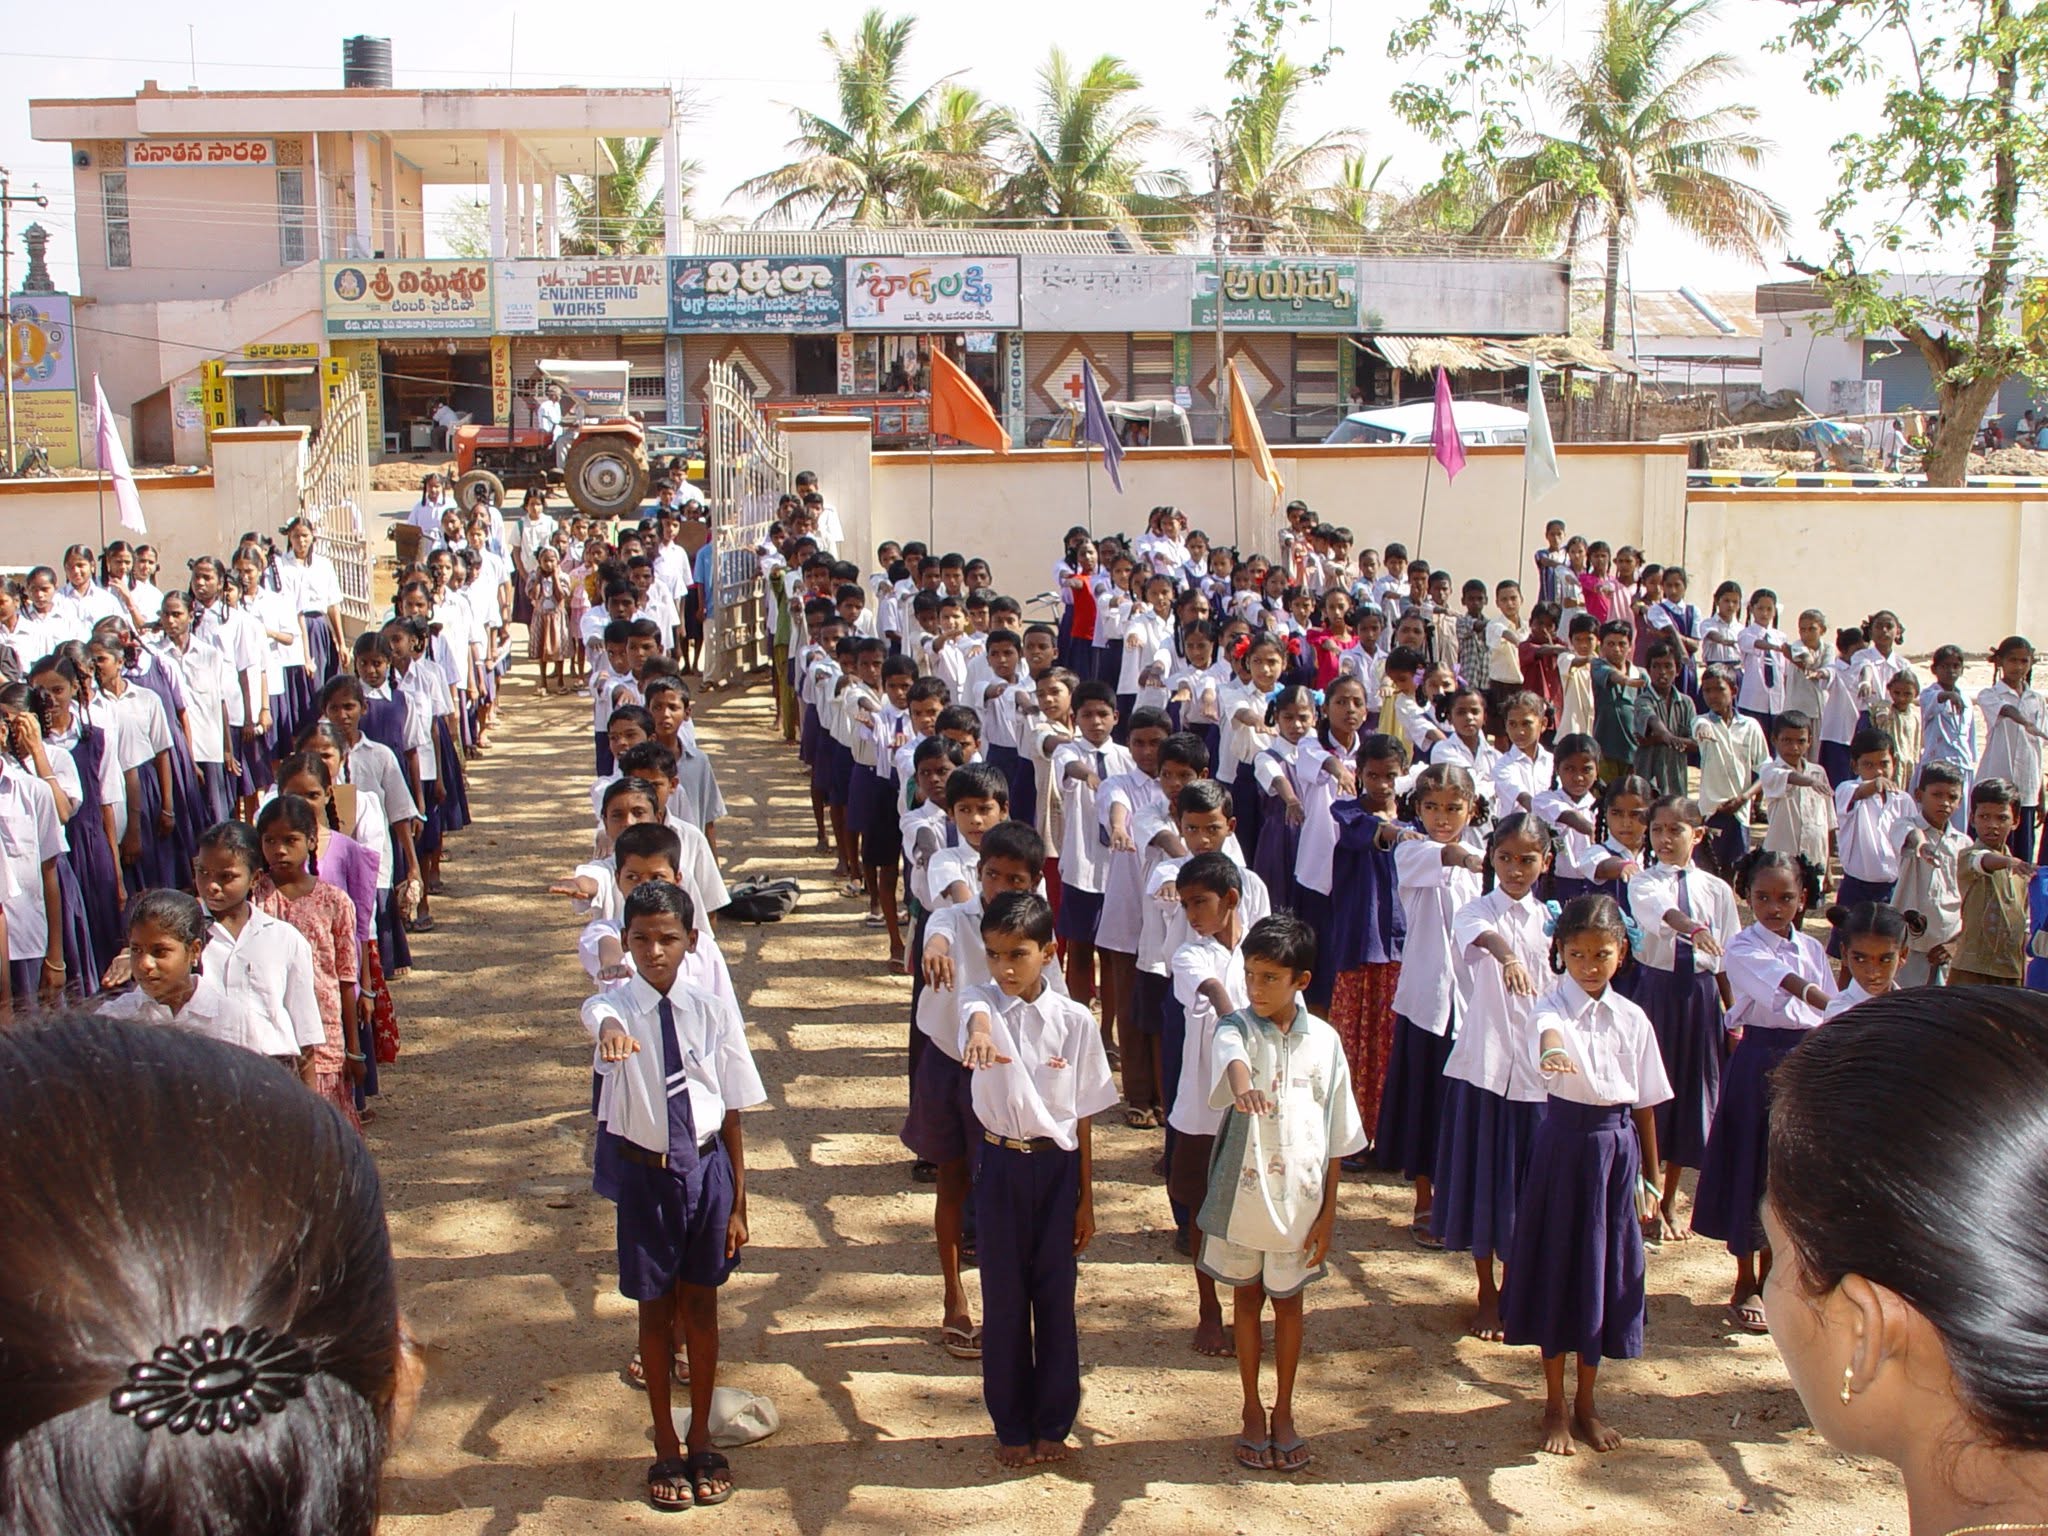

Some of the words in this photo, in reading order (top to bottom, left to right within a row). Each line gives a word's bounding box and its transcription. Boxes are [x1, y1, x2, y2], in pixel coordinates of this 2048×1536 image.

[134, 142, 203, 162] సనాతన
[867, 264, 993, 313] భాగ్యలక్ష్మి
[553, 302, 606, 316] WORKS
[586, 389, 621, 402] JOSEPH
